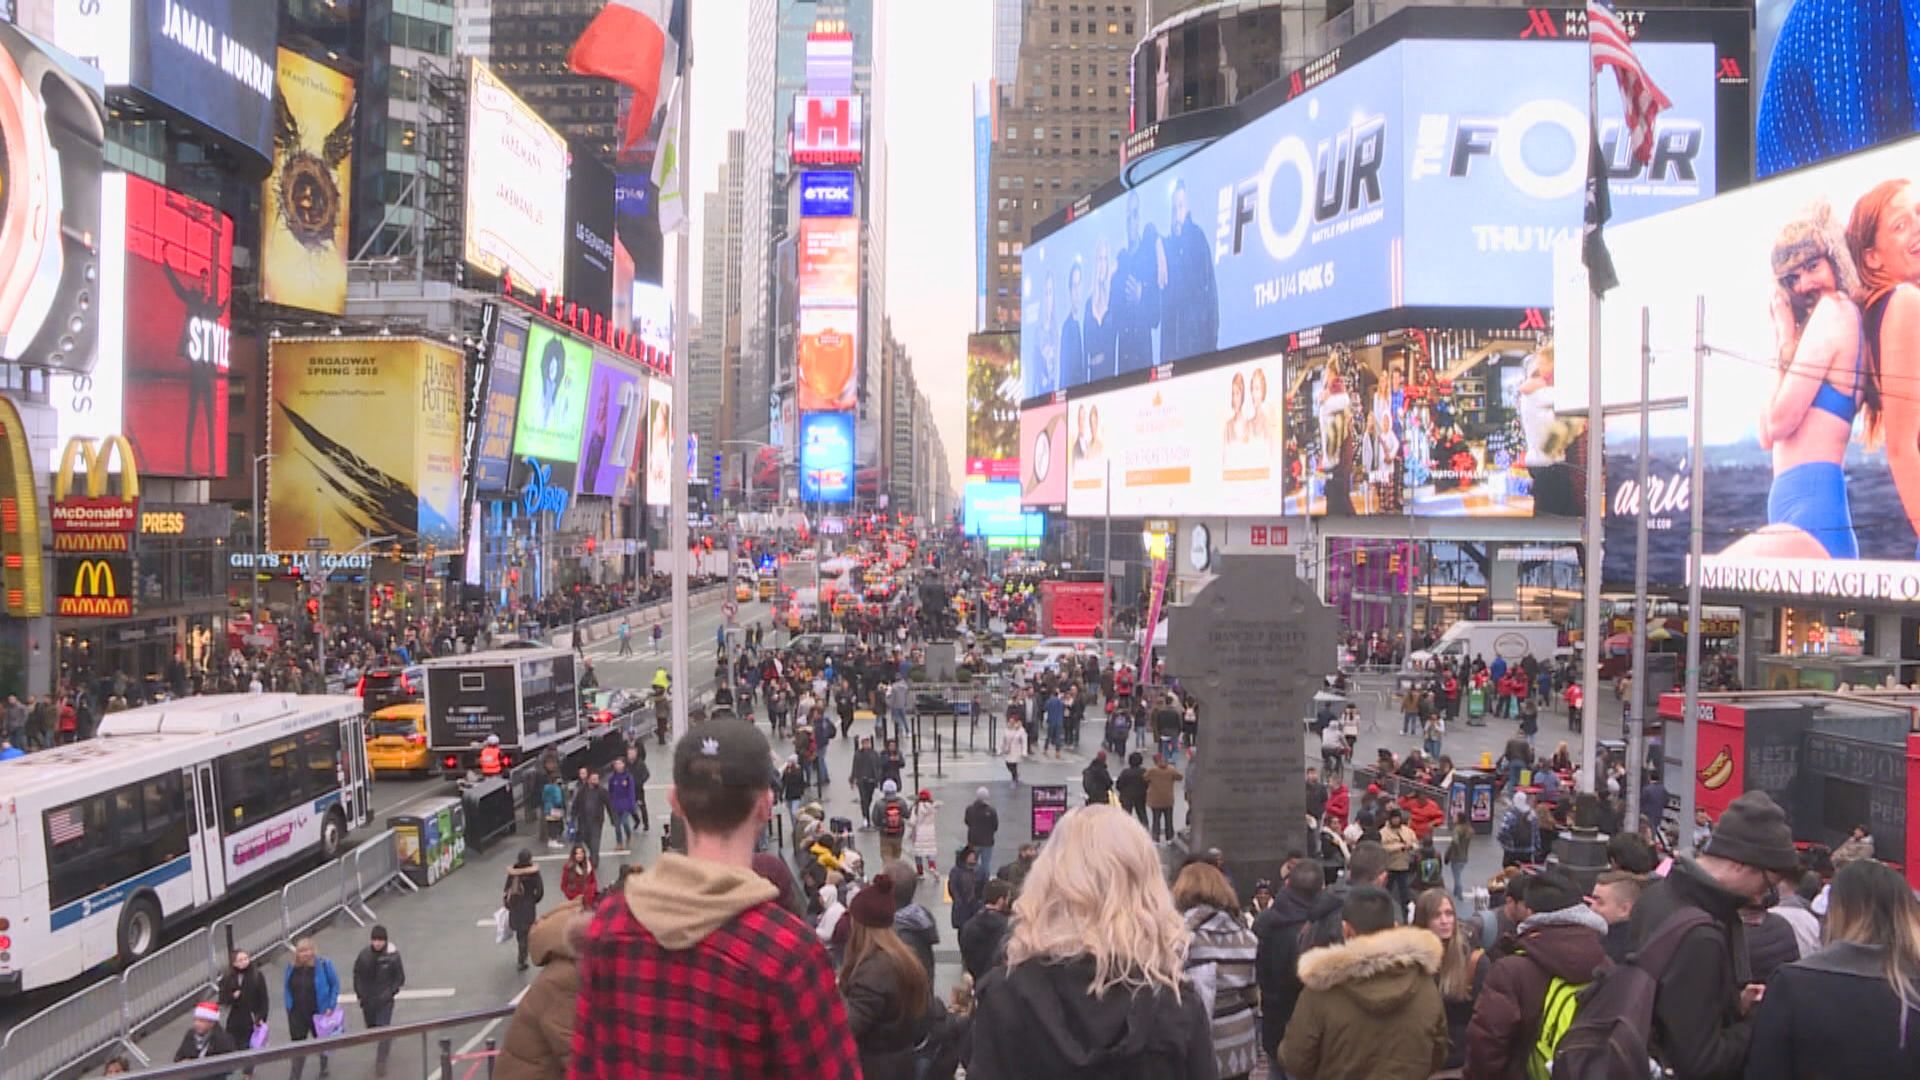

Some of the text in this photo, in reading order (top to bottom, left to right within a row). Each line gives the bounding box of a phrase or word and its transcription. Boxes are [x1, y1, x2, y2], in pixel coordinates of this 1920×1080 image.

[163, 0, 274, 100] JAMAL MURRAY
[1305, 48, 1340, 76] MARRIOTT
[1305, 62, 1336, 88] MARQUIS
[1127, 124, 1160, 148] MARRIOTT
[1127, 138, 1154, 158] MARQUIS
[816, 187, 849, 199] TDK
[1231, 113, 1387, 263] FOUR
[1254, 278, 1280, 308] THU
[1298, 263, 1324, 295] FOX
[307, 367, 350, 376] SPRING
[309, 356, 377, 366] BROADWAY
[53, 507, 133, 519] McDonald's
[141, 511, 184, 534] PRESS
[1702, 565, 1802, 593] MERICAN
[1812, 569, 1891, 599] EAGLE
